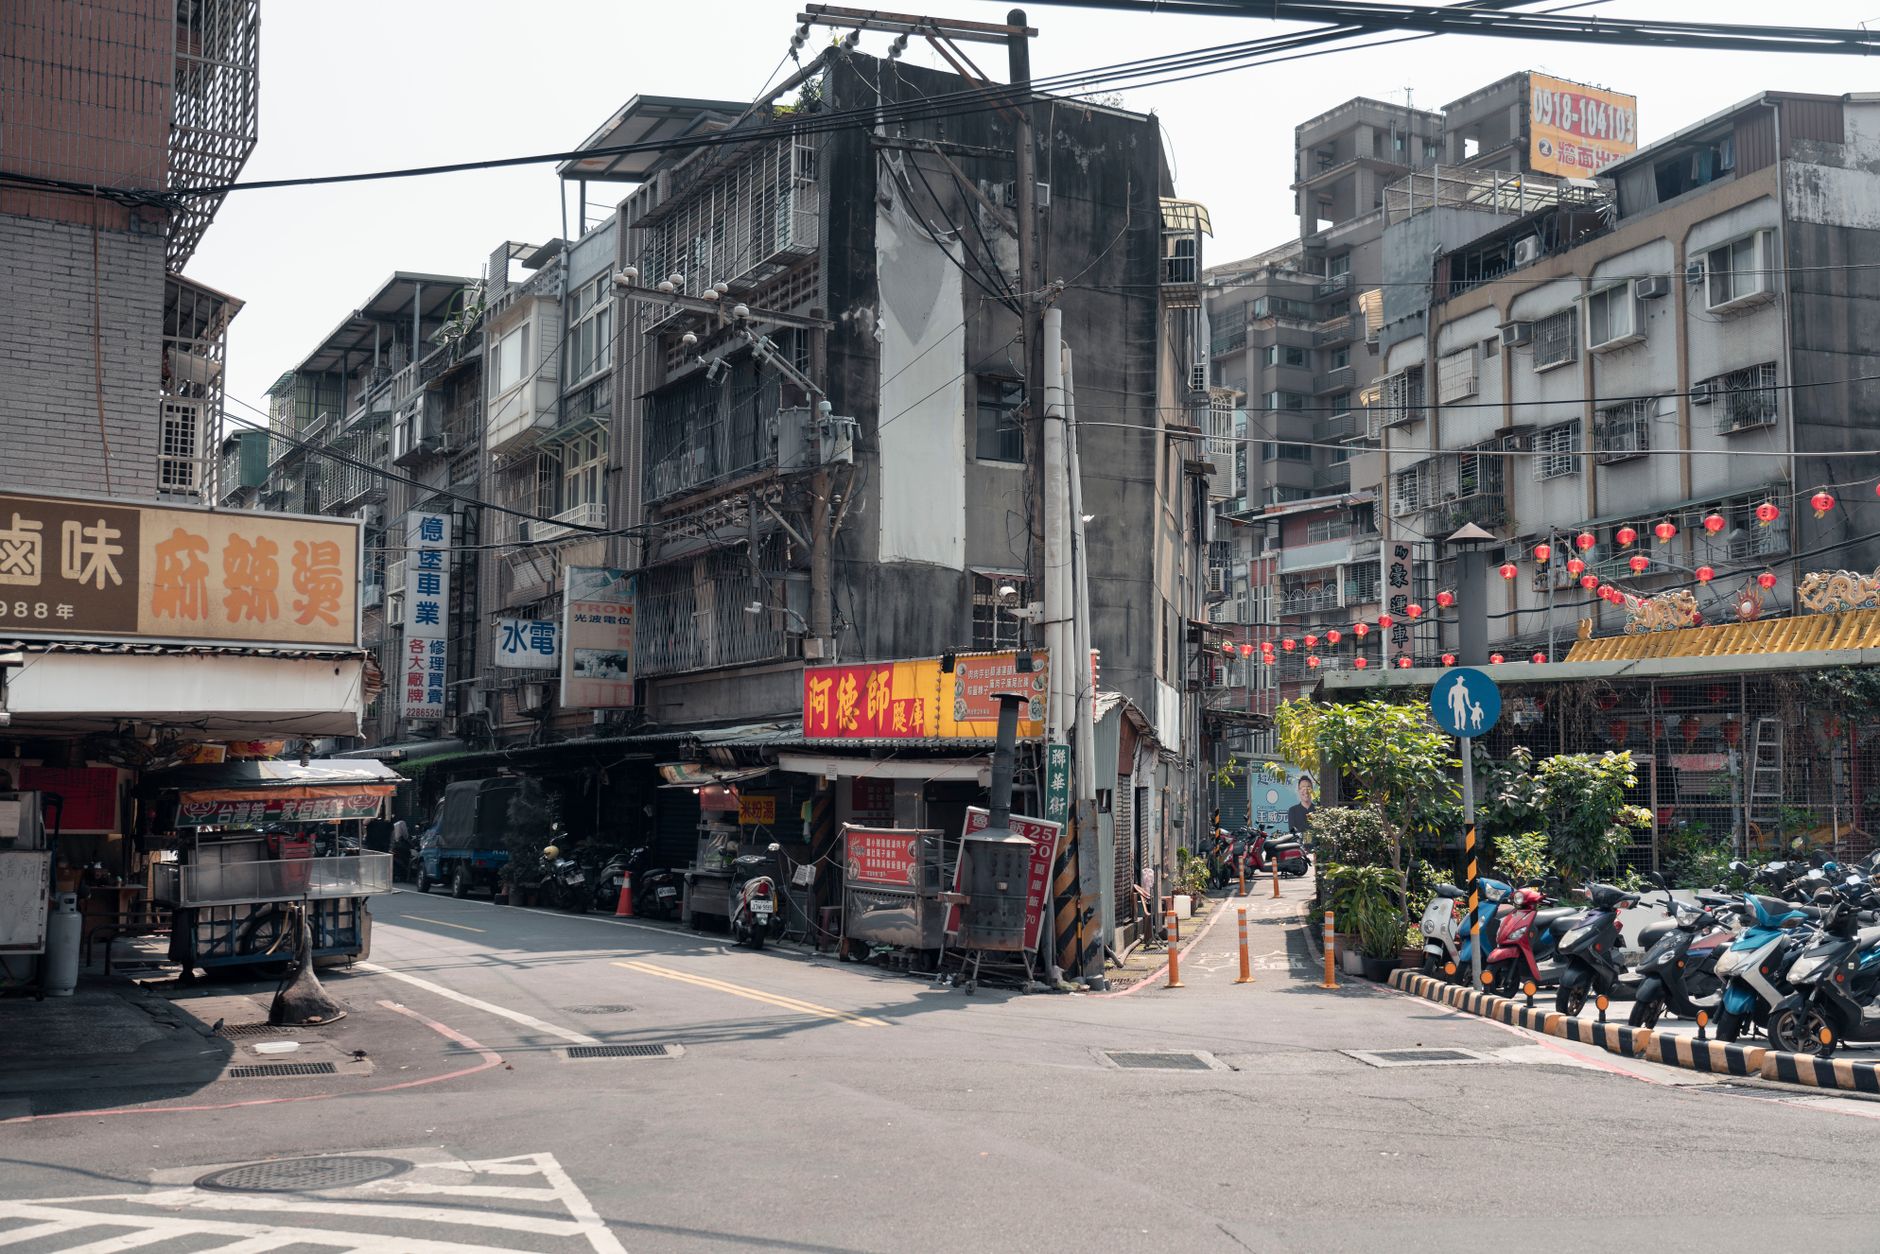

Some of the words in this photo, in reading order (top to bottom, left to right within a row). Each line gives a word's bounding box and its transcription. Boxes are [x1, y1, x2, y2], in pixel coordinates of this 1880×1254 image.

[1533, 86, 1635, 145] 0918-104103
[1558, 141, 1625, 169] 牆面出
[152, 527, 343, 626] 麻辣燙
[415, 516, 445, 625] 億堡車業
[502, 620, 556, 656] 水電
[574, 603, 633, 615] TRON
[574, 614, 631, 625] 光波電位
[407, 638, 425, 704] 各大廠牌
[427, 639, 445, 705] 修理買賣
[808, 669, 891, 731] 阿德師
[1029, 826, 1053, 842] 25
